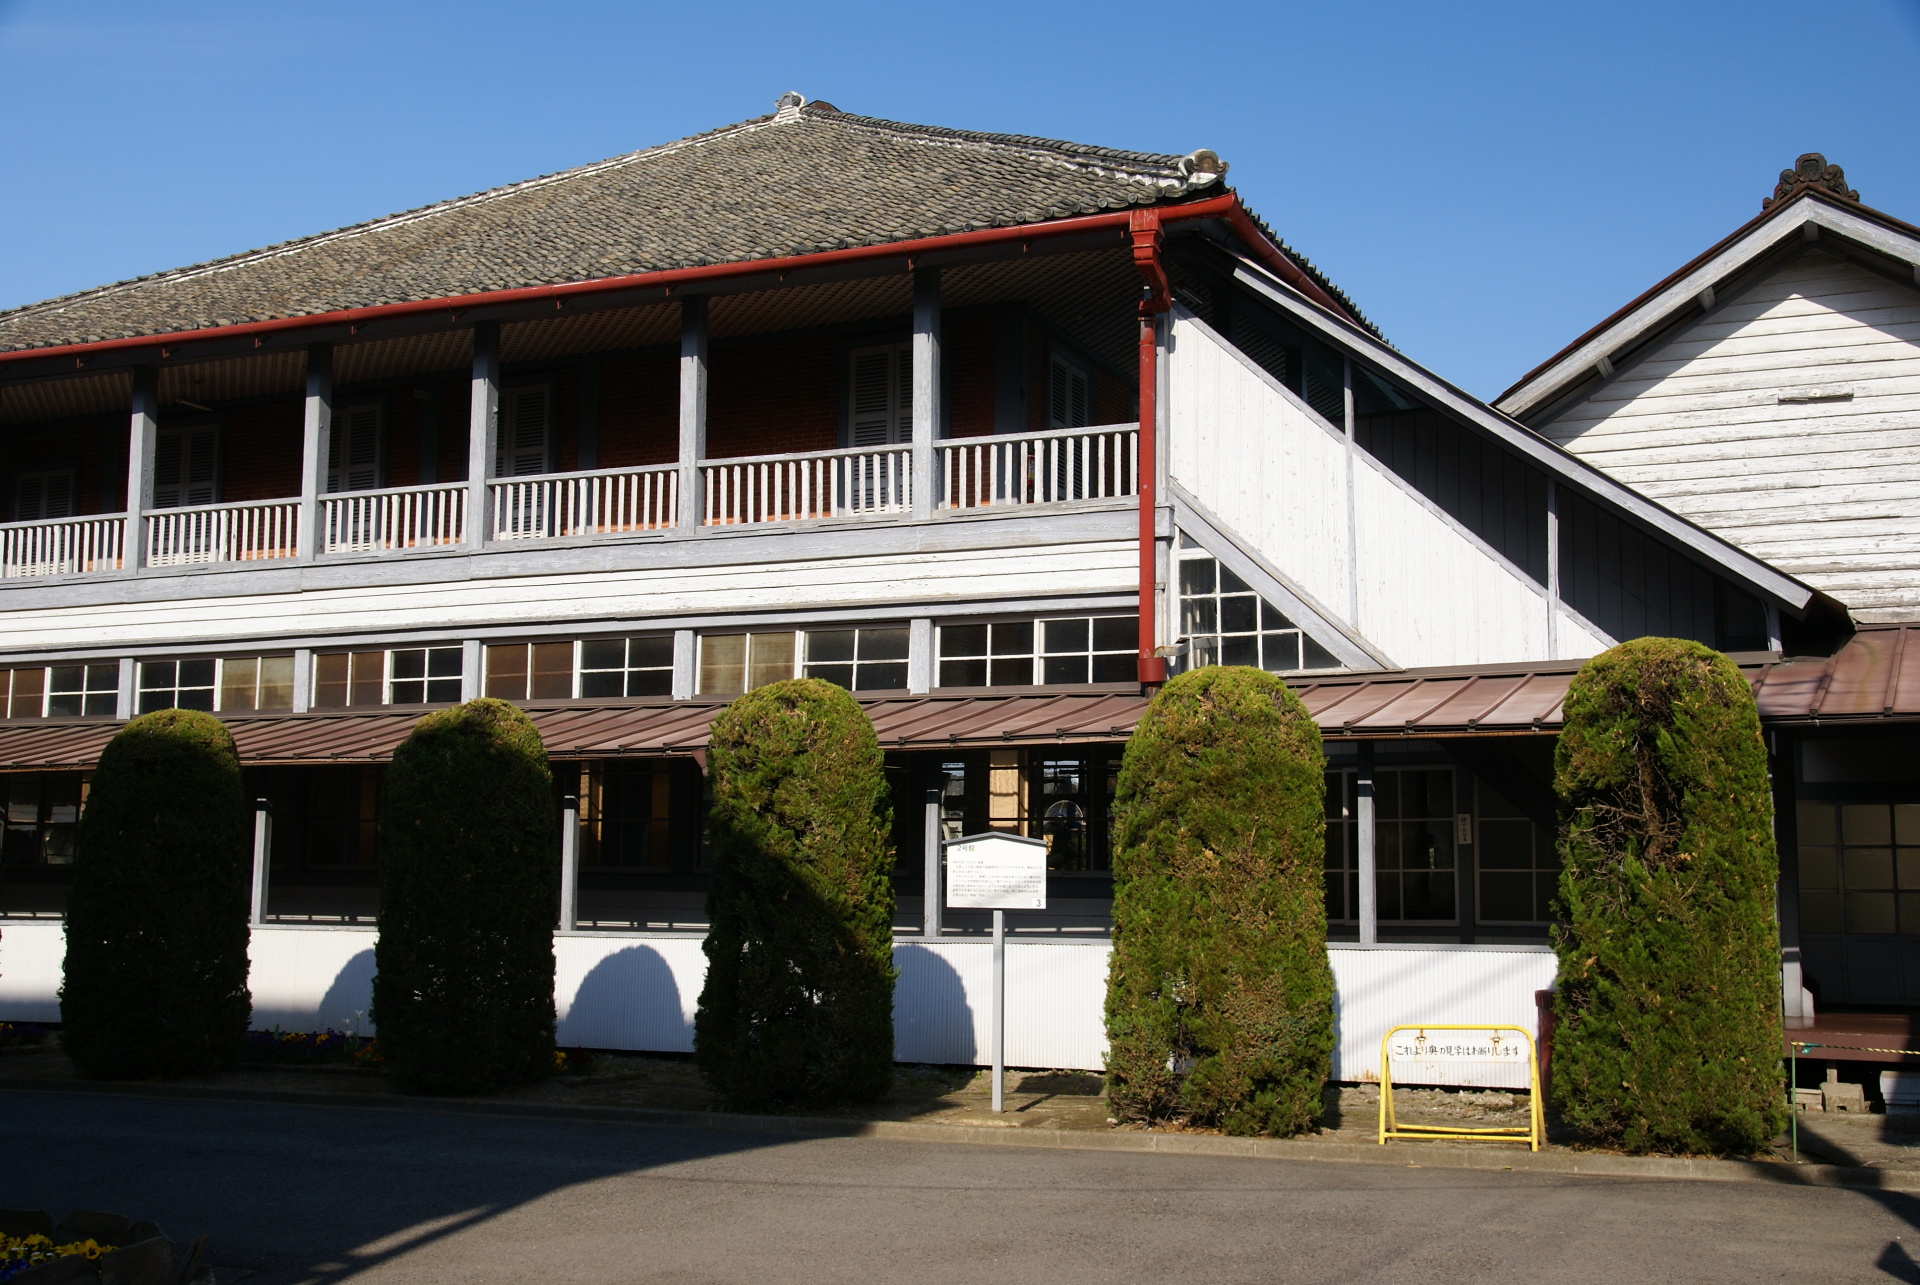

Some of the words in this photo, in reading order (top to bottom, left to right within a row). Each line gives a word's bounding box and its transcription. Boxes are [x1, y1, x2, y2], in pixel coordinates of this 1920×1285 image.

[1036, 899, 1041, 907] 3
[1395, 1045, 1519, 1056] これより奥の見学はお断りします
